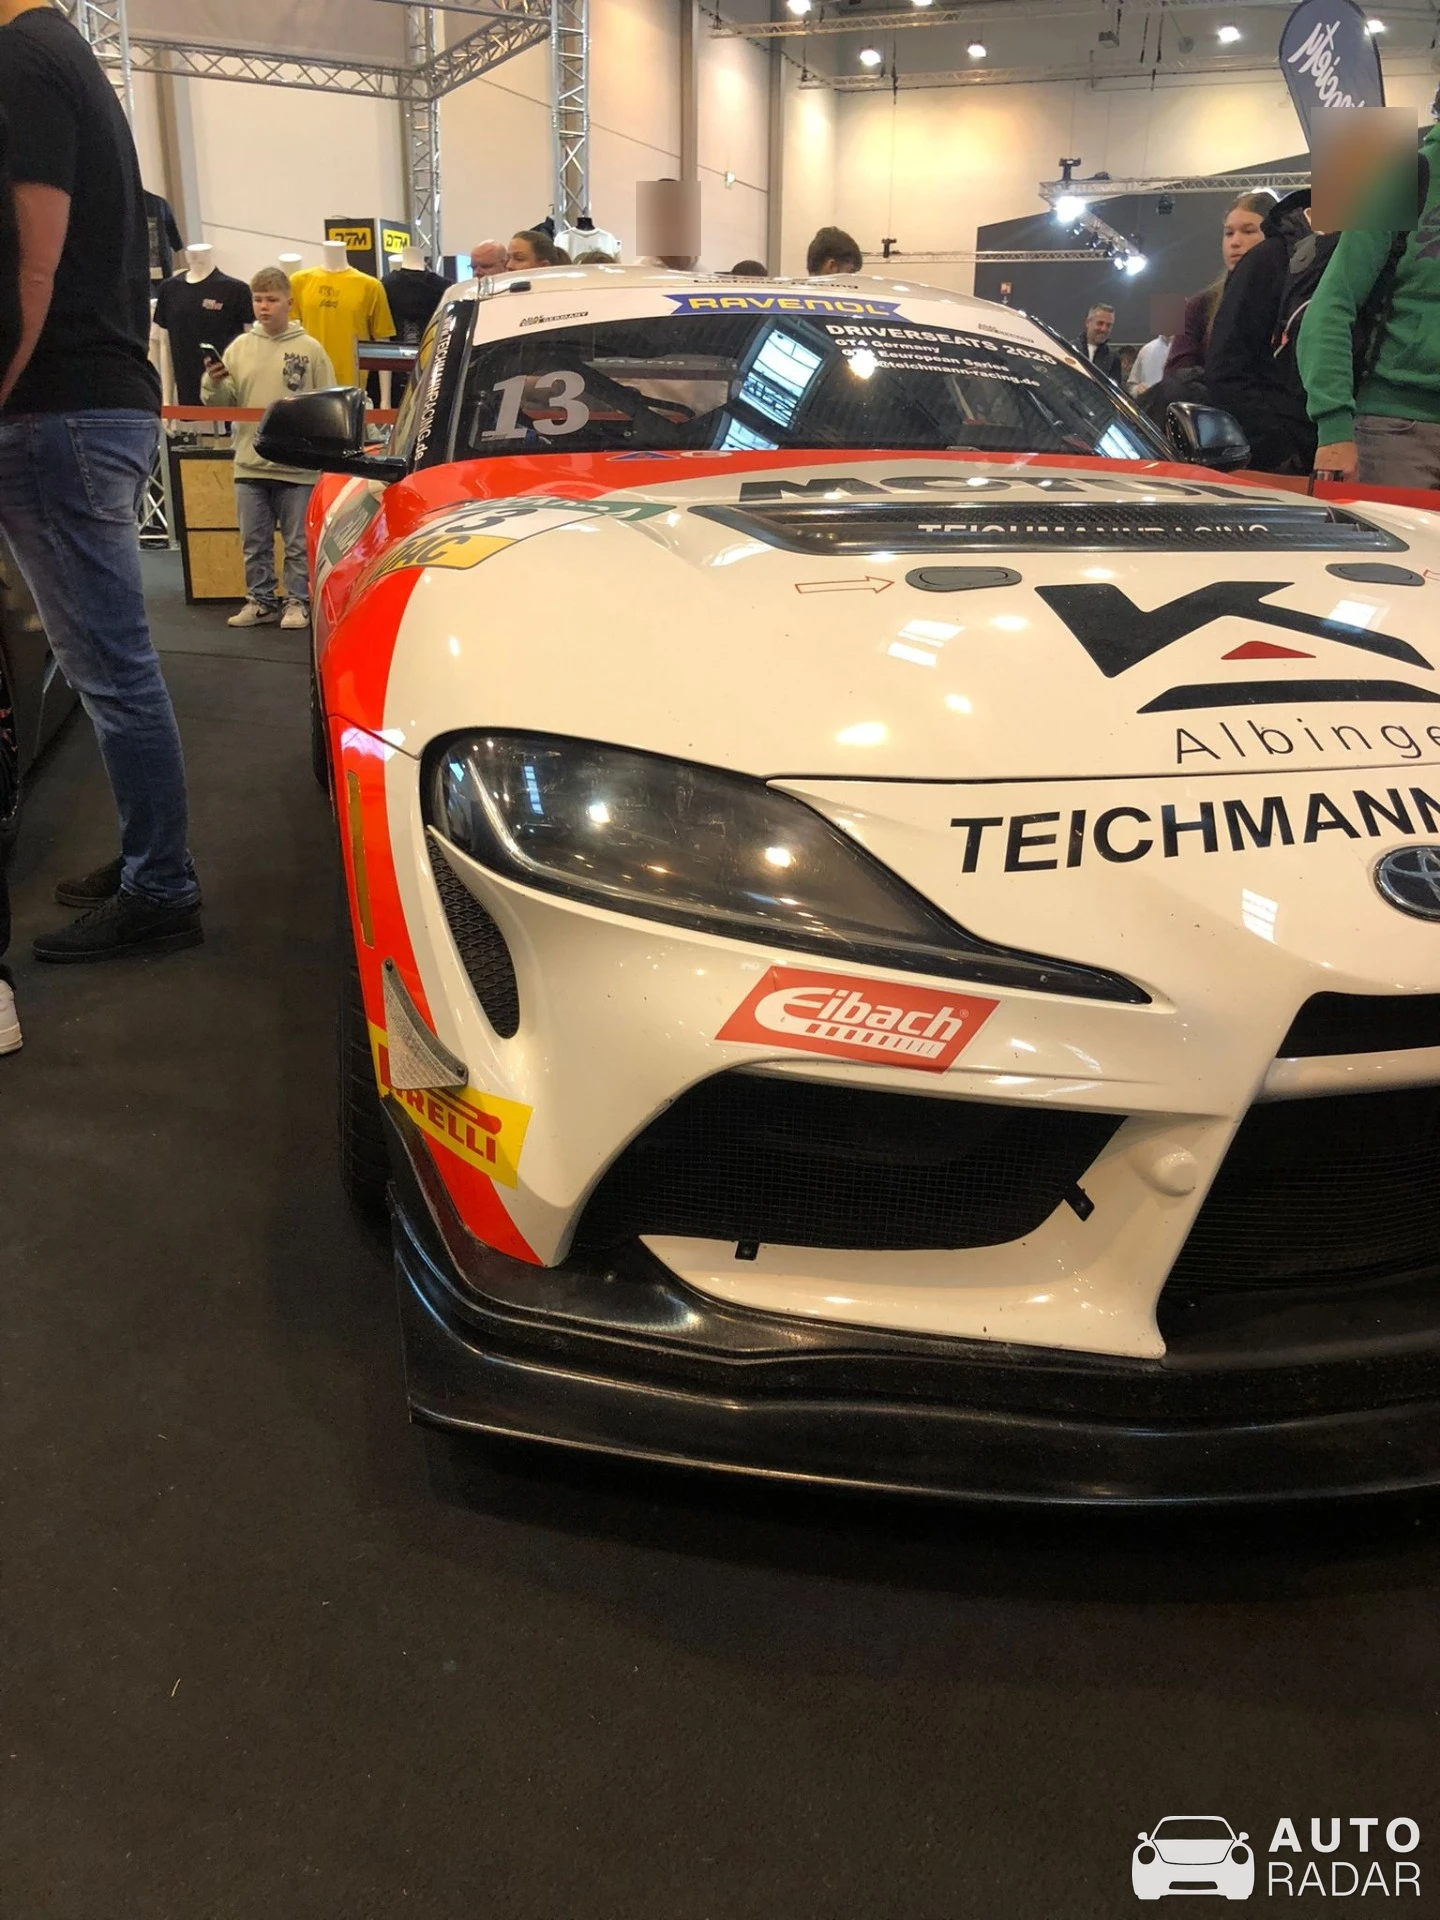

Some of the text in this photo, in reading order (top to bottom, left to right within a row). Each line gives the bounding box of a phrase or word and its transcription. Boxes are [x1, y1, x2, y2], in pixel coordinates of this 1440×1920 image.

[385, 234, 408, 248] DTM
[688, 297, 890, 316] RAVENOL
[825, 325, 998, 352] DRIVERSEATS
[1002, 344, 1058, 366] 2026
[835, 339, 940, 353] GT4 Germany
[963, 358, 1010, 372] Series
[480, 370, 590, 442] 13
[739, 476, 1280, 502] MOTUL
[754, 986, 963, 1042] Eibach
